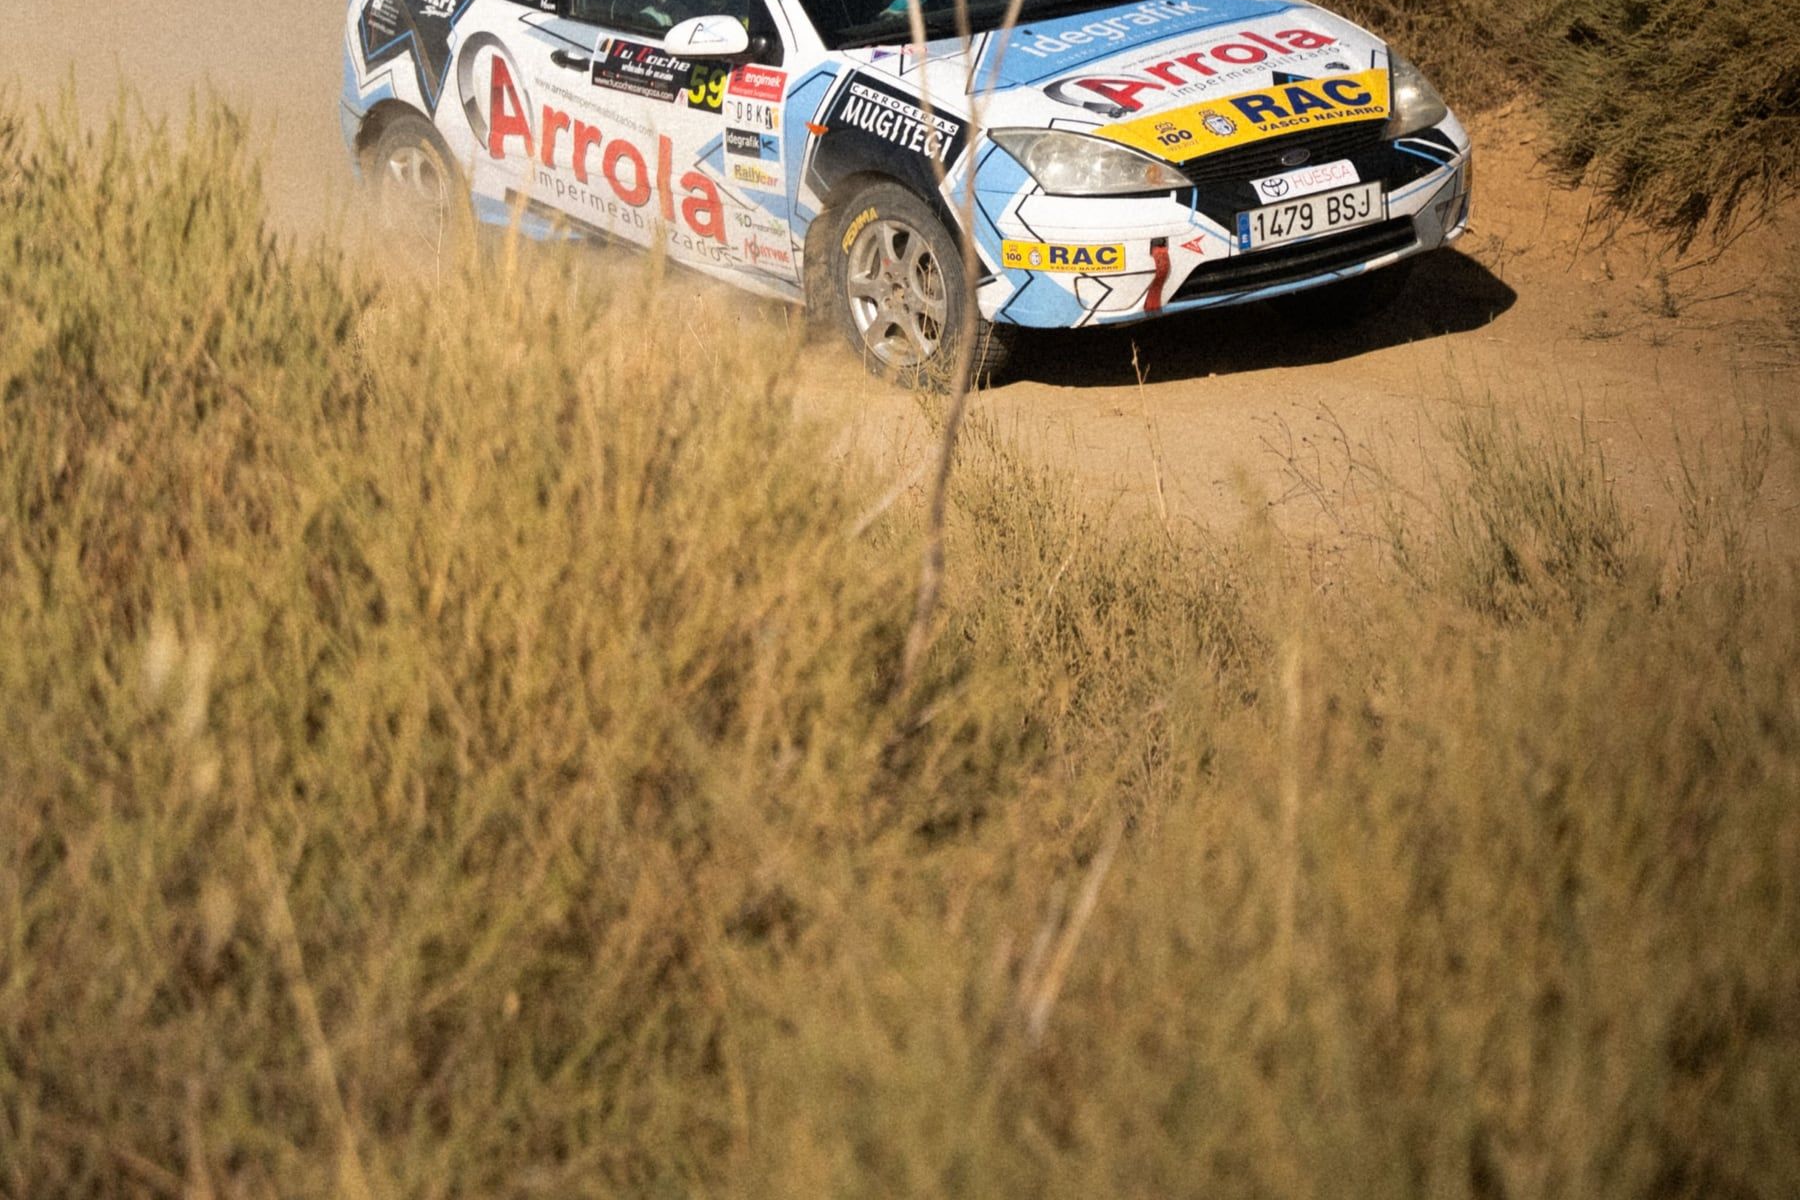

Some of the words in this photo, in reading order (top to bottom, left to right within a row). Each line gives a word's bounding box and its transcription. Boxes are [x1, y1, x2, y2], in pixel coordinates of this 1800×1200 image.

[613, 41, 634, 60] Tu
[636, 46, 691, 72] Coche
[1073, 28, 1339, 113] Arrola
[1168, 40, 1351, 99] impermeabilizados
[688, 64, 727, 108] 59
[745, 71, 782, 88] engimek
[852, 84, 957, 134] CARROCERIAS
[1229, 78, 1373, 125] RAC
[840, 95, 953, 163] MUGITEGI
[1257, 116, 1311, 133] VASCO
[1314, 106, 1385, 123] NAVARRO
[487, 53, 728, 245] Arrola
[727, 131, 760, 149] idegrafik
[1157, 129, 1194, 147] 100
[734, 164, 779, 187] Rallycar
[1290, 164, 1352, 190] HUESCA
[1257, 202, 1314, 241] 1479
[1327, 188, 1371, 226] BSJ
[1006, 252, 1022, 262] 100
[1050, 246, 1118, 265] RAC
